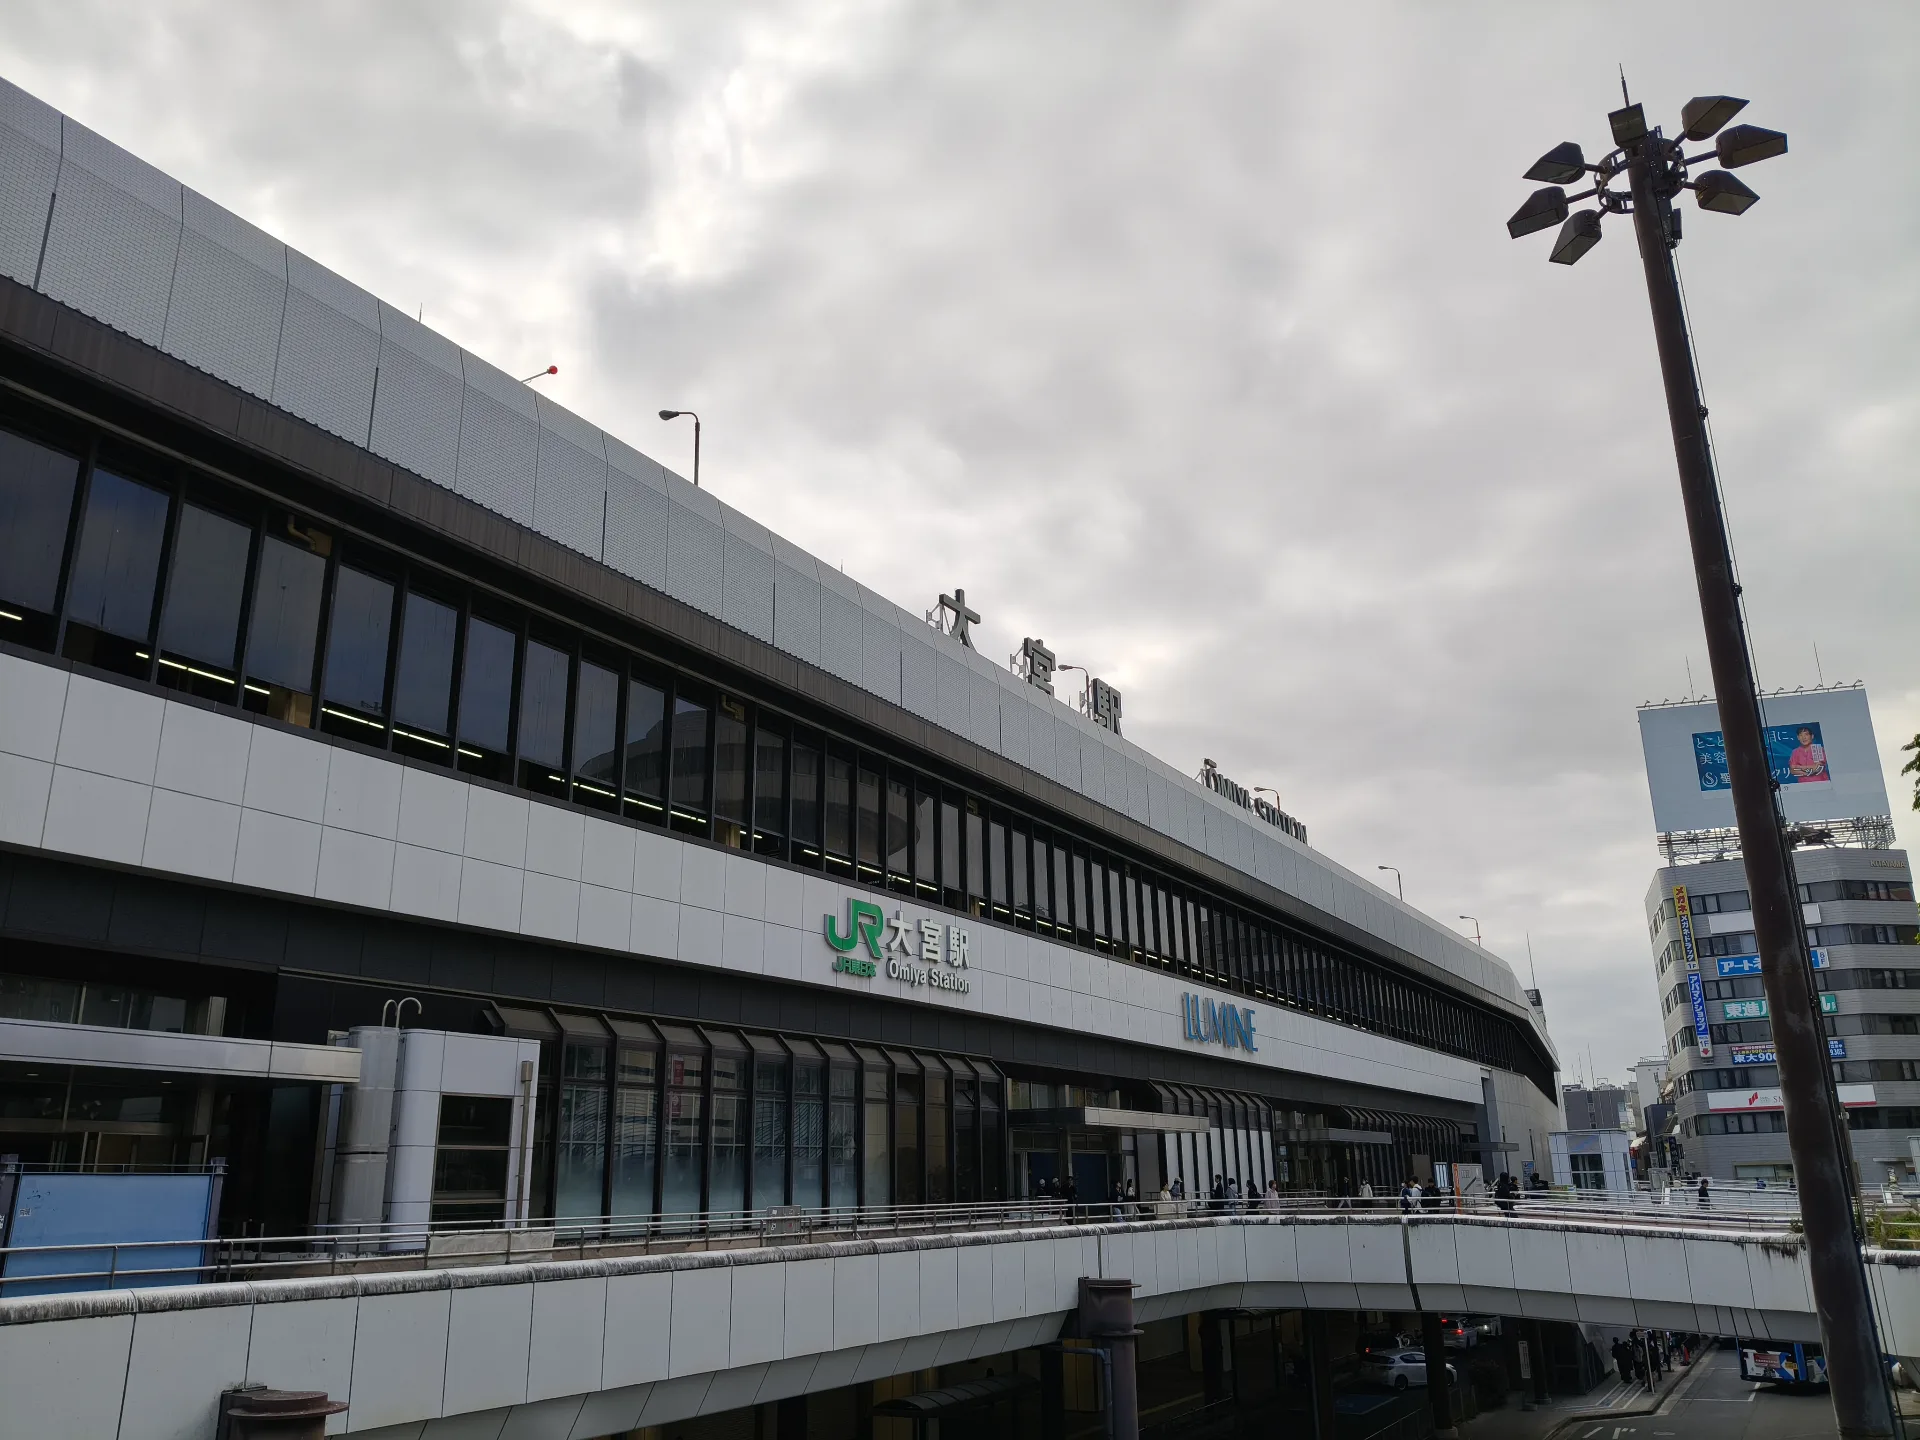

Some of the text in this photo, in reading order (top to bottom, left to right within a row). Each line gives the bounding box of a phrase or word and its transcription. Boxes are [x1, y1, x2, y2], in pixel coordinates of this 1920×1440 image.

[1870, 859, 1906, 869] KITAYAMA
[1675, 886, 1688, 913] メガネ
[824, 897, 885, 960] JR
[886, 910, 970, 970] 大宮駅
[832, 955, 877, 978] JR東日本
[1687, 962, 1697, 970] 1F
[1819, 951, 1826, 965] 8F
[928, 967, 971, 994] Station
[1689, 975, 1707, 1030] アパマンショップ
[1182, 992, 1259, 1053] LUMINE
[1699, 1040, 1709, 1048] 1F
